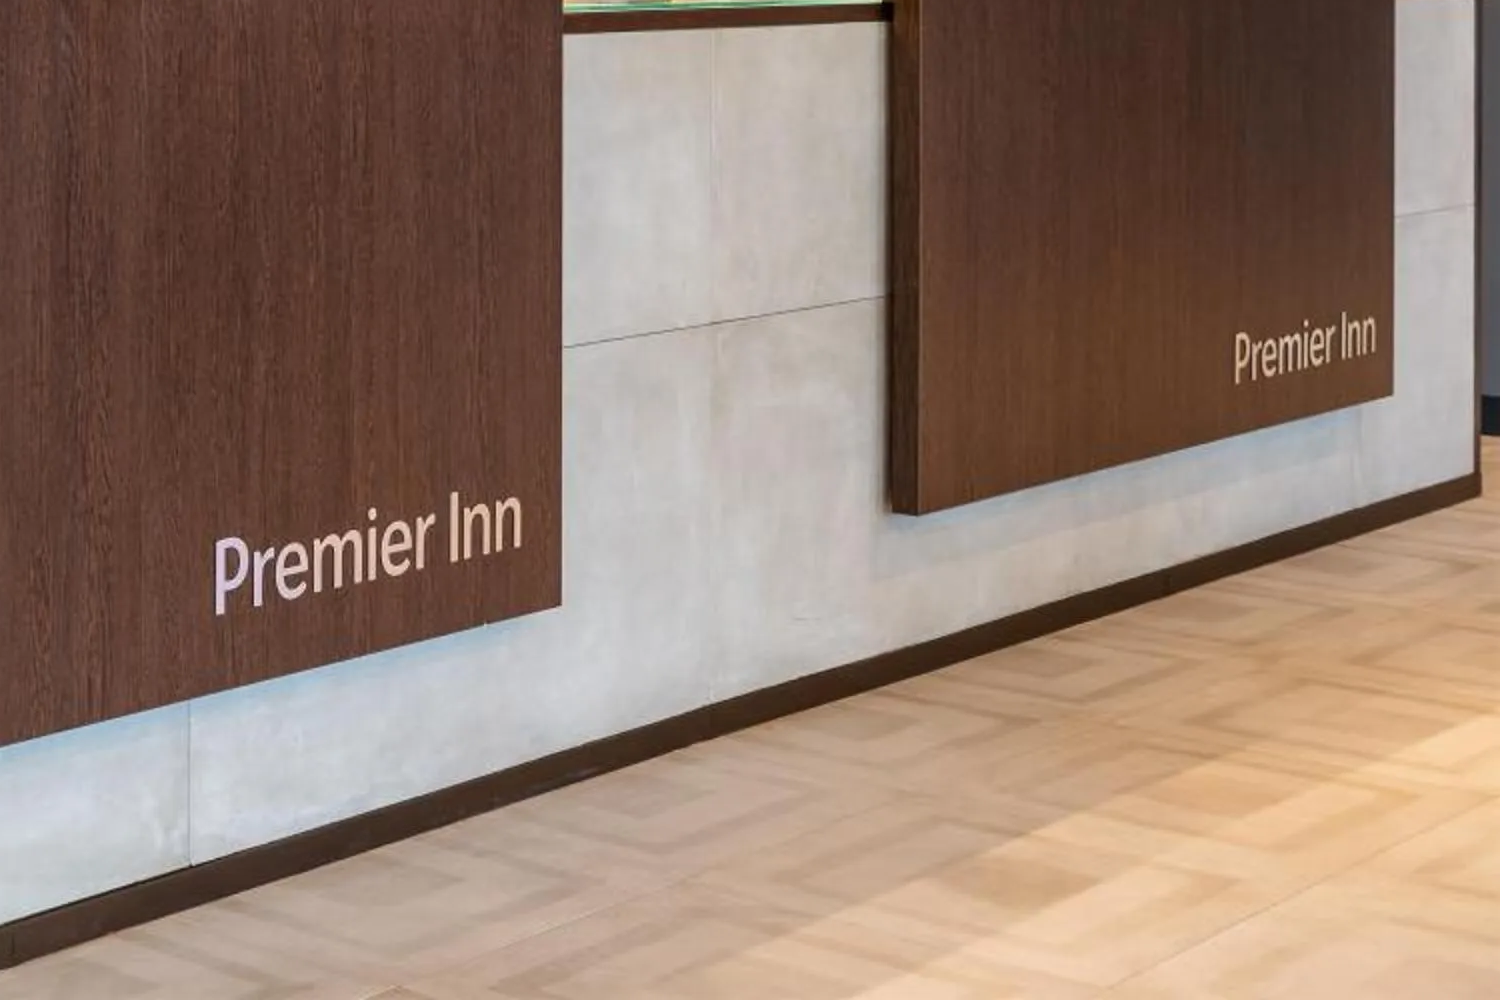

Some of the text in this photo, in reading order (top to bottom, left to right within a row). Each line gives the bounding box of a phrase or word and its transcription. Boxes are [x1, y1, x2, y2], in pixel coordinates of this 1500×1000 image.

[1234, 311, 1377, 385] Premier Inn
[215, 491, 522, 616] Premier Inn
